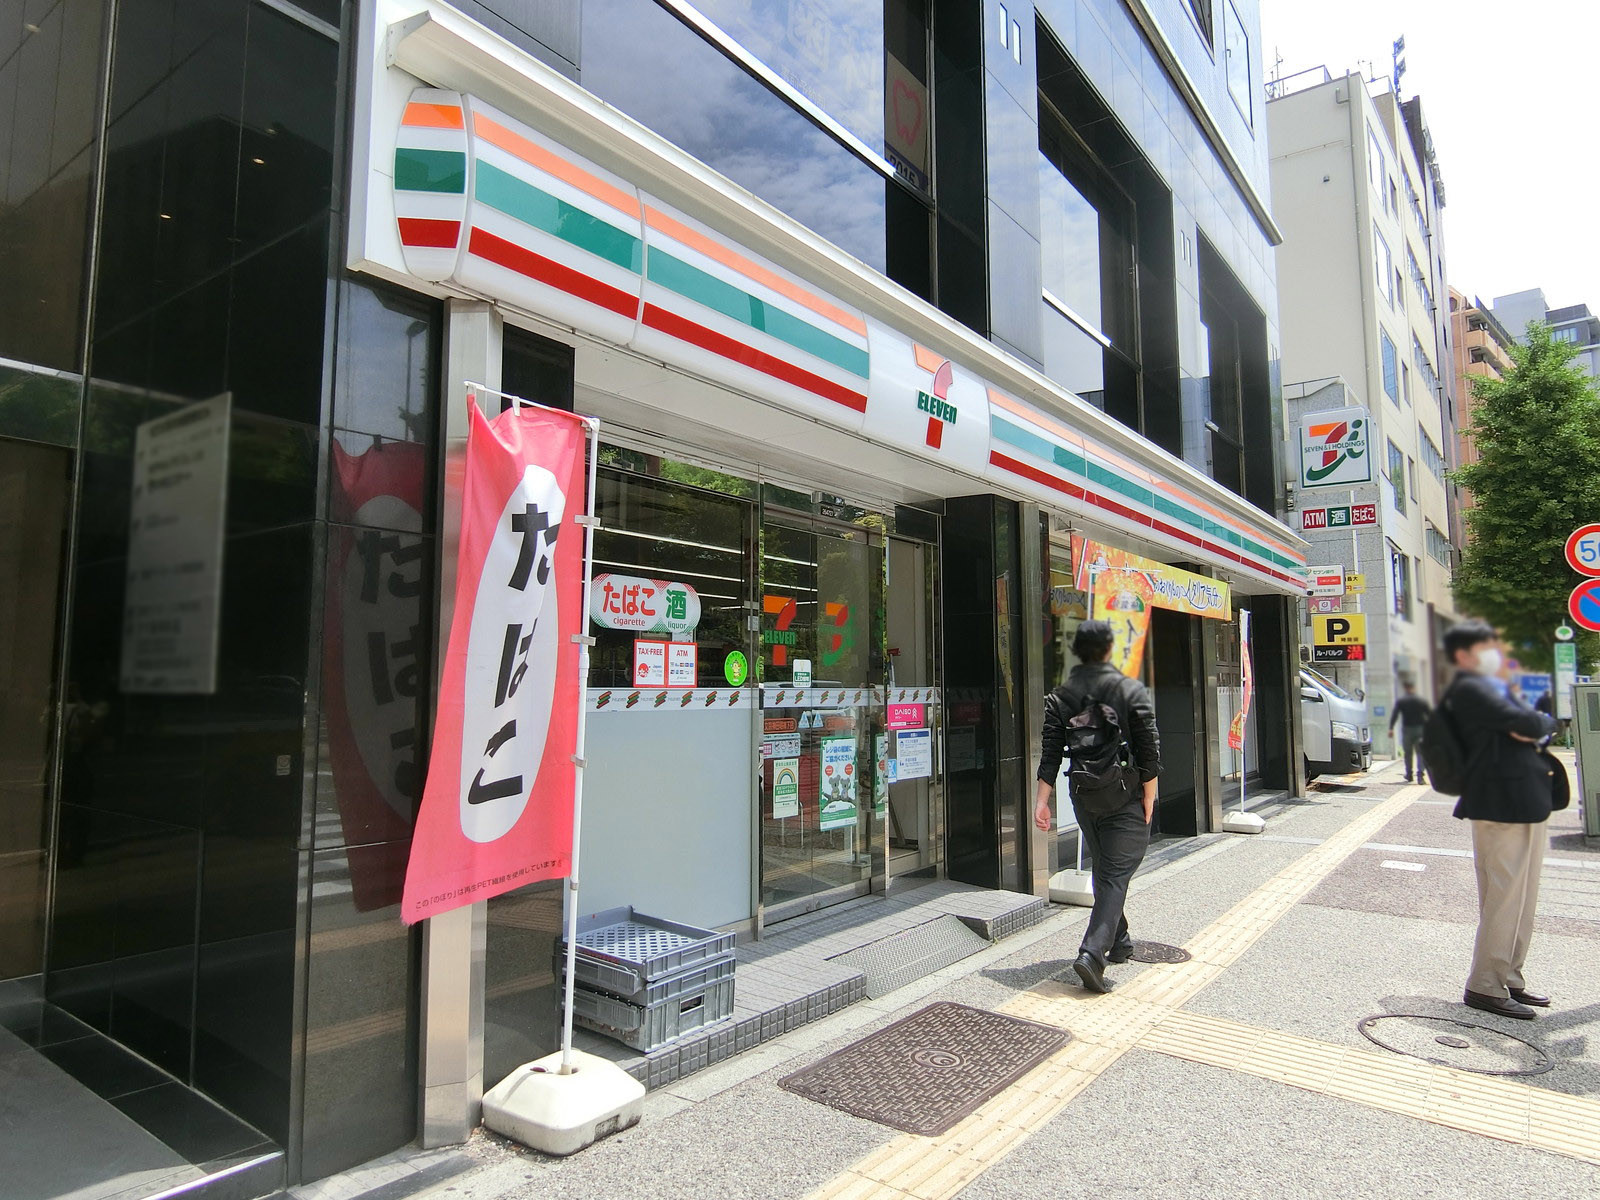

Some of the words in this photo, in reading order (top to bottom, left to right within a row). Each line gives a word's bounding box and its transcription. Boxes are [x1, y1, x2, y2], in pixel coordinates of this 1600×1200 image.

[1332, 440, 1365, 449] HOLDINGS
[1304, 512, 1325, 526] ATM
[1331, 510, 1347, 525] 酒
[1352, 507, 1375, 522] たばこ
[603, 581, 656, 616] たばこ
[666, 588, 687, 619] 酒
[613, 617, 646, 627] cigarette
[667, 621, 687, 630] liquor
[1327, 618, 1350, 643] P
[637, 647, 663, 656] TAX-FREE
[1346, 646, 1363, 660] 満
[894, 708, 912, 716] DAISO
